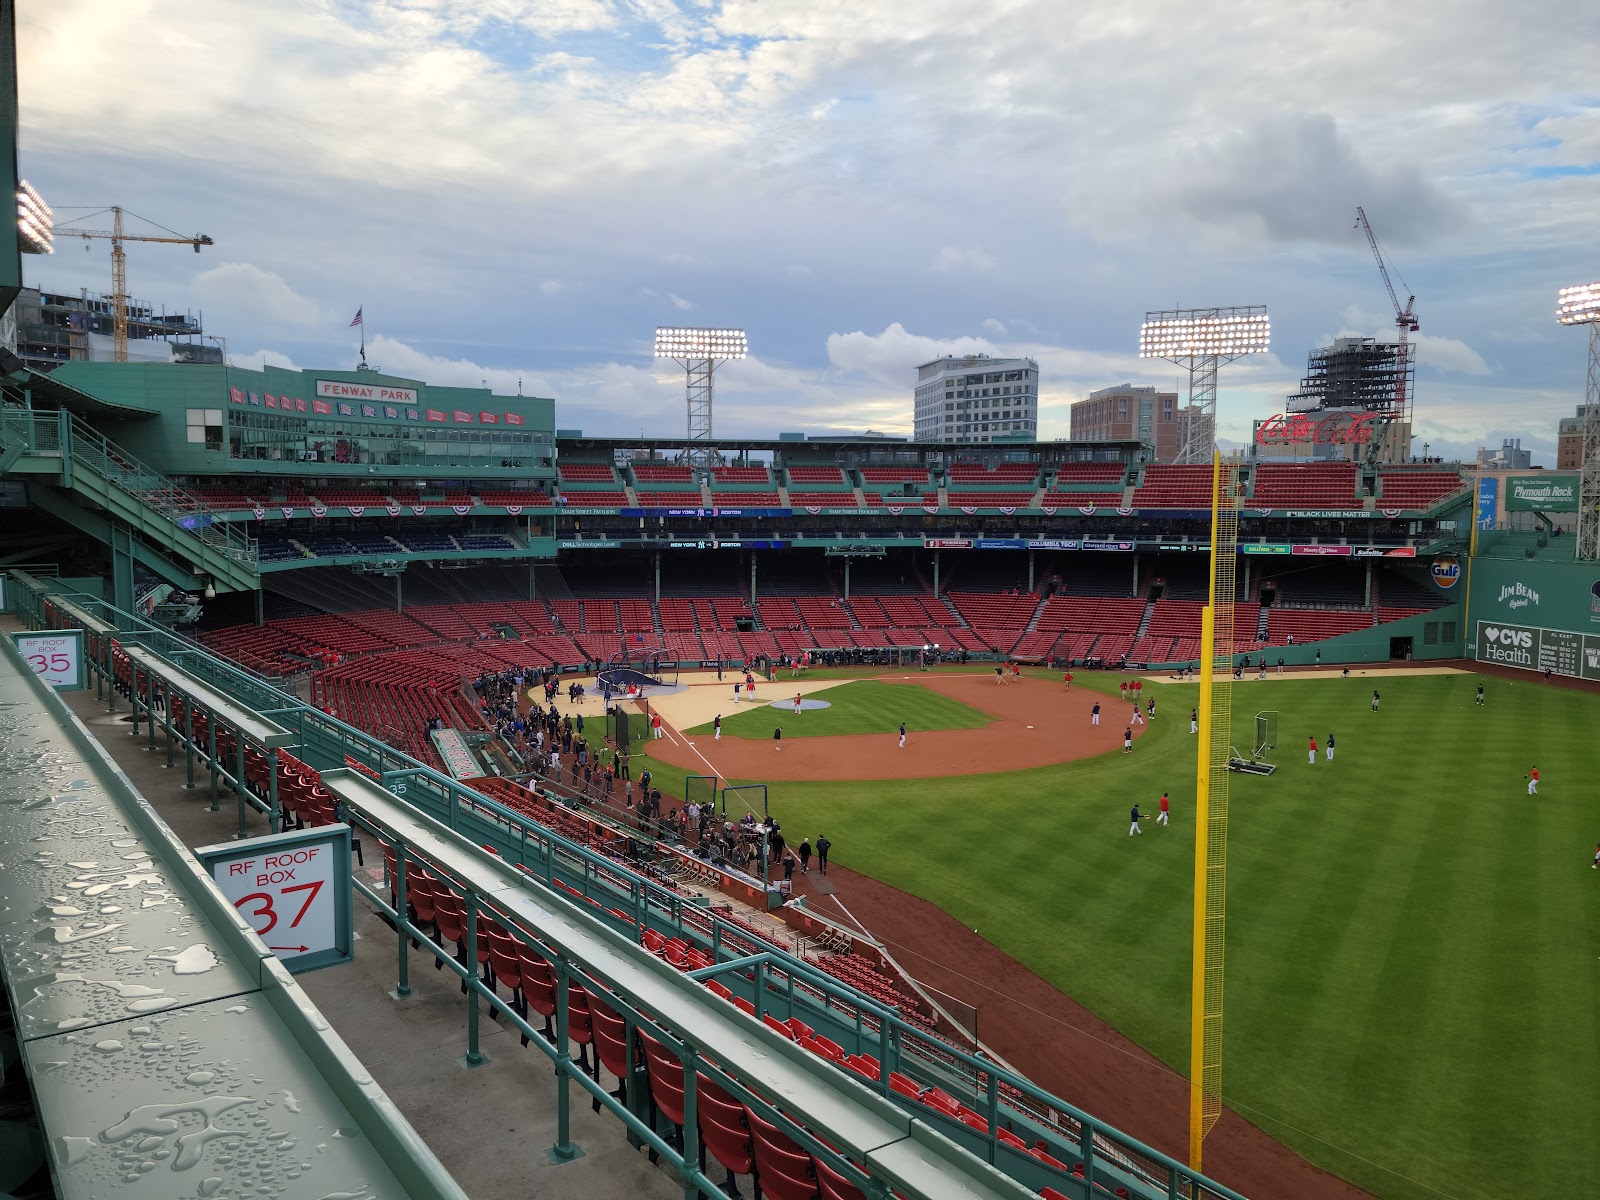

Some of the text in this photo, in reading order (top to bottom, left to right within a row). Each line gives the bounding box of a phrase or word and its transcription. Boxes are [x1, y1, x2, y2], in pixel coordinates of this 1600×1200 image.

[324, 384, 411, 401] FENWAY PARK
[1513, 486, 1573, 498] Plymouth Rock
[575, 541, 602, 549] Technologies
[1431, 564, 1458, 577] Gulf
[1498, 582, 1539, 605] JIM BEAM
[1499, 628, 1533, 648] CVS
[28, 653, 71, 673] 35
[1485, 643, 1532, 665] Health
[389, 783, 407, 795] 35
[229, 848, 320, 877] RF ROOF
[256, 868, 296, 887] BOX
[233, 880, 325, 936] 37
